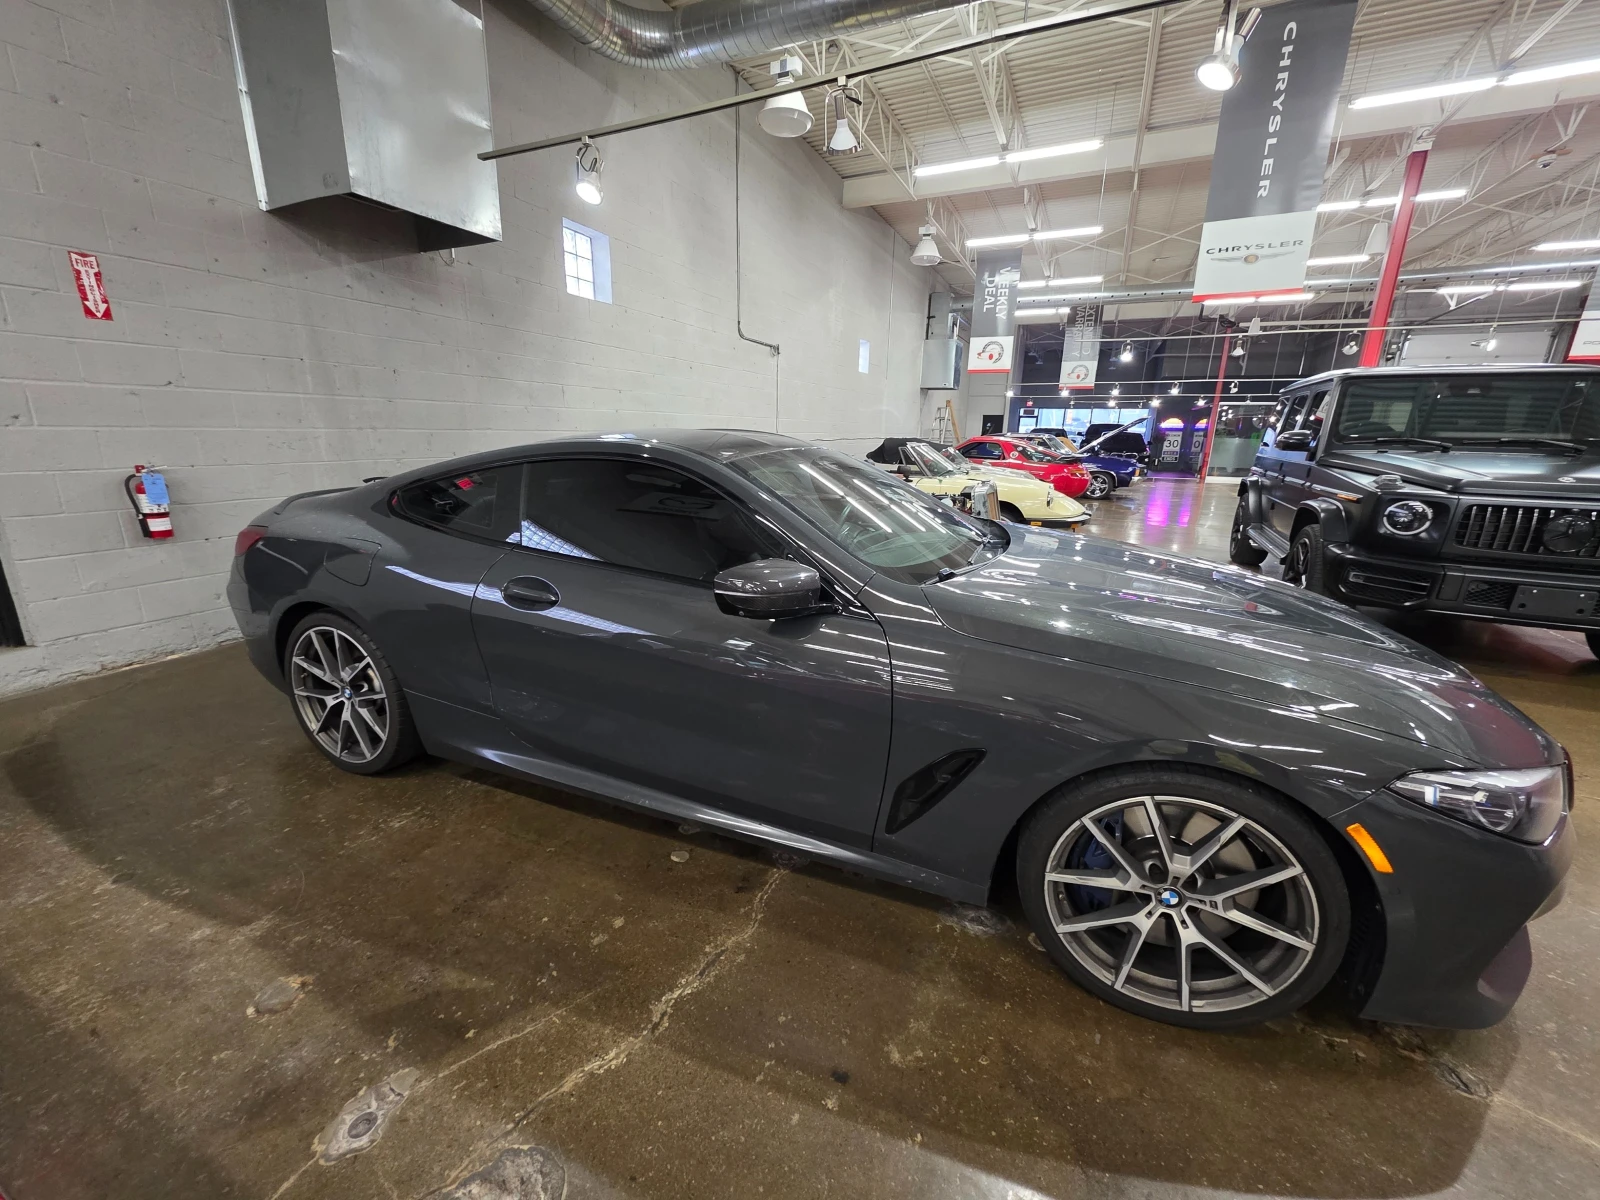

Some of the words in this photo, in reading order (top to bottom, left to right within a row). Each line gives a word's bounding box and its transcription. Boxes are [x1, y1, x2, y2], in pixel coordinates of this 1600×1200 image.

[1257, 21, 1297, 199] CHRYSLER
[1206, 239, 1304, 255] CHRYSLER
[74, 257, 95, 270] FIRE
[983, 277, 996, 313] DEAL
[1165, 439, 1179, 448] 30
